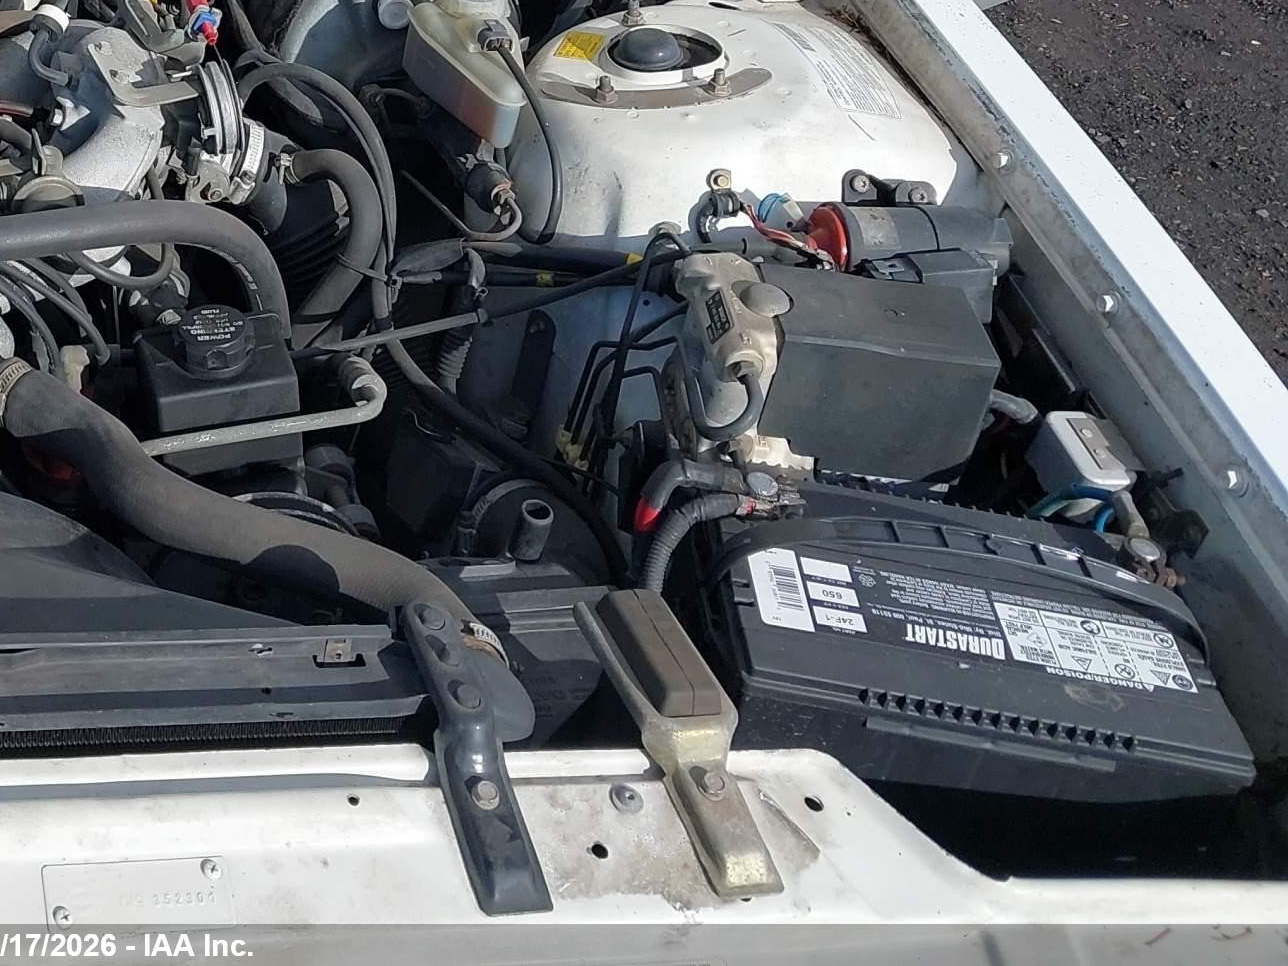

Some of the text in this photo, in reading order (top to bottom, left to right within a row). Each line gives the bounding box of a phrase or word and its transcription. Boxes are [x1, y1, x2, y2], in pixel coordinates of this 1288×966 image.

[822, 589, 842, 599] 650
[825, 613, 853, 625] 24F-1
[905, 623, 1005, 660] DURASTART
[1046, 666, 1146, 689] DANGER/POISON
